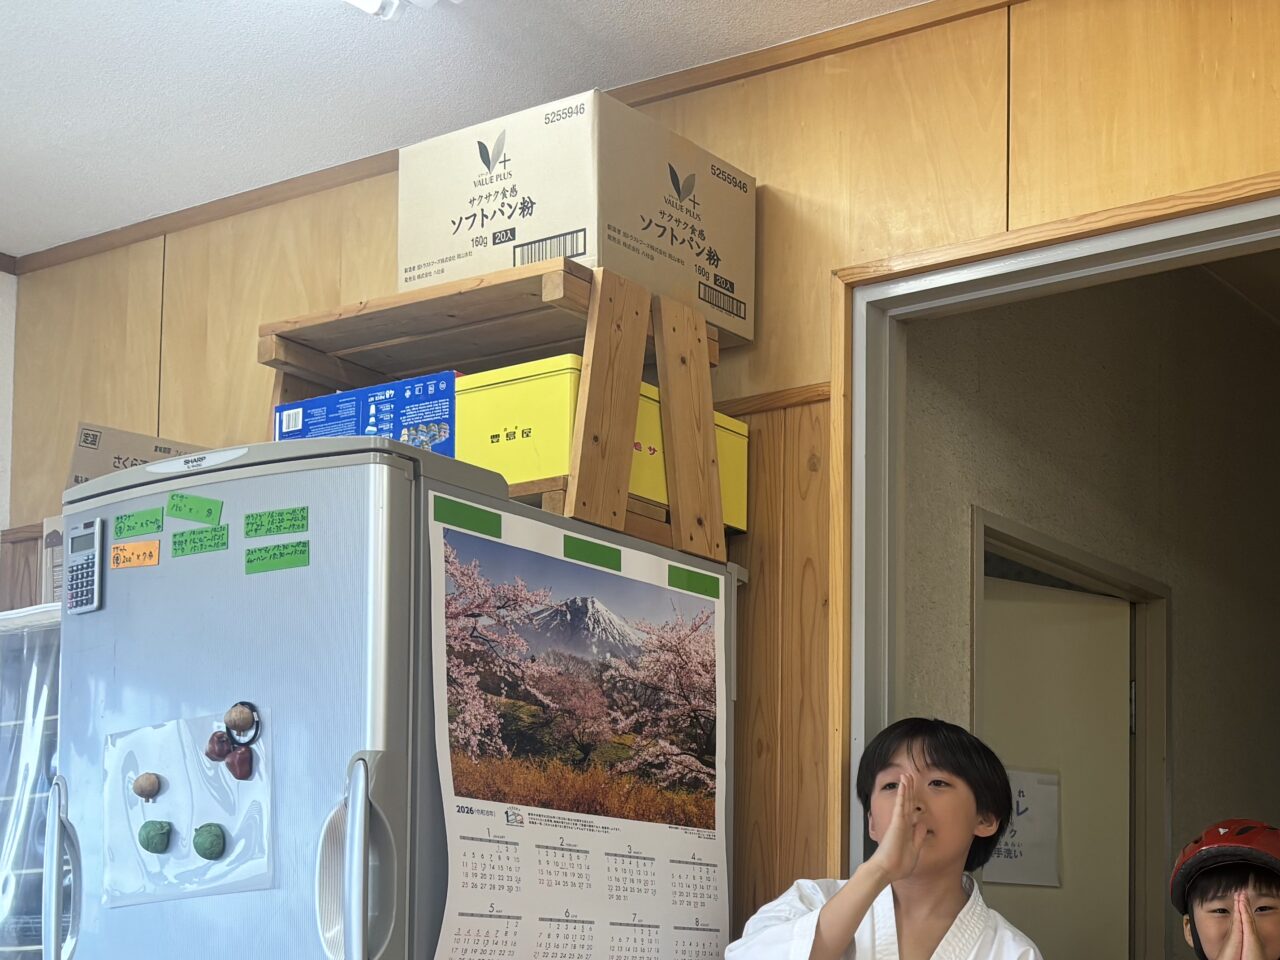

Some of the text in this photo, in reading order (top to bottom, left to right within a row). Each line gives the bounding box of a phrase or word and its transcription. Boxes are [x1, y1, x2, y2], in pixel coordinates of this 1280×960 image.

[544, 104, 585, 124] 5255946
[474, 175, 494, 188] VALUE
[496, 171, 512, 182] PLUS
[711, 164, 748, 193] 5255946
[469, 184, 518, 208] サクサク食感
[451, 196, 536, 235] ソフトパン粉
[664, 196, 684, 213] VALUE
[686, 208, 701, 221] PLUS
[659, 210, 706, 241] サクサク食感
[470, 230, 512, 248] 160g 20入
[640, 215, 721, 269] ソフトパン粉
[694, 264, 732, 291] 160g 20入
[184, 456, 206, 465] SHARP
[456, 805, 474, 814] 2026
[560, 837, 565, 846] 2
[628, 845, 632, 853] 3
[488, 903, 495, 913] 5
[565, 909, 570, 918] 6
[632, 913, 637, 922] 7
[695, 918, 699, 926] 8
